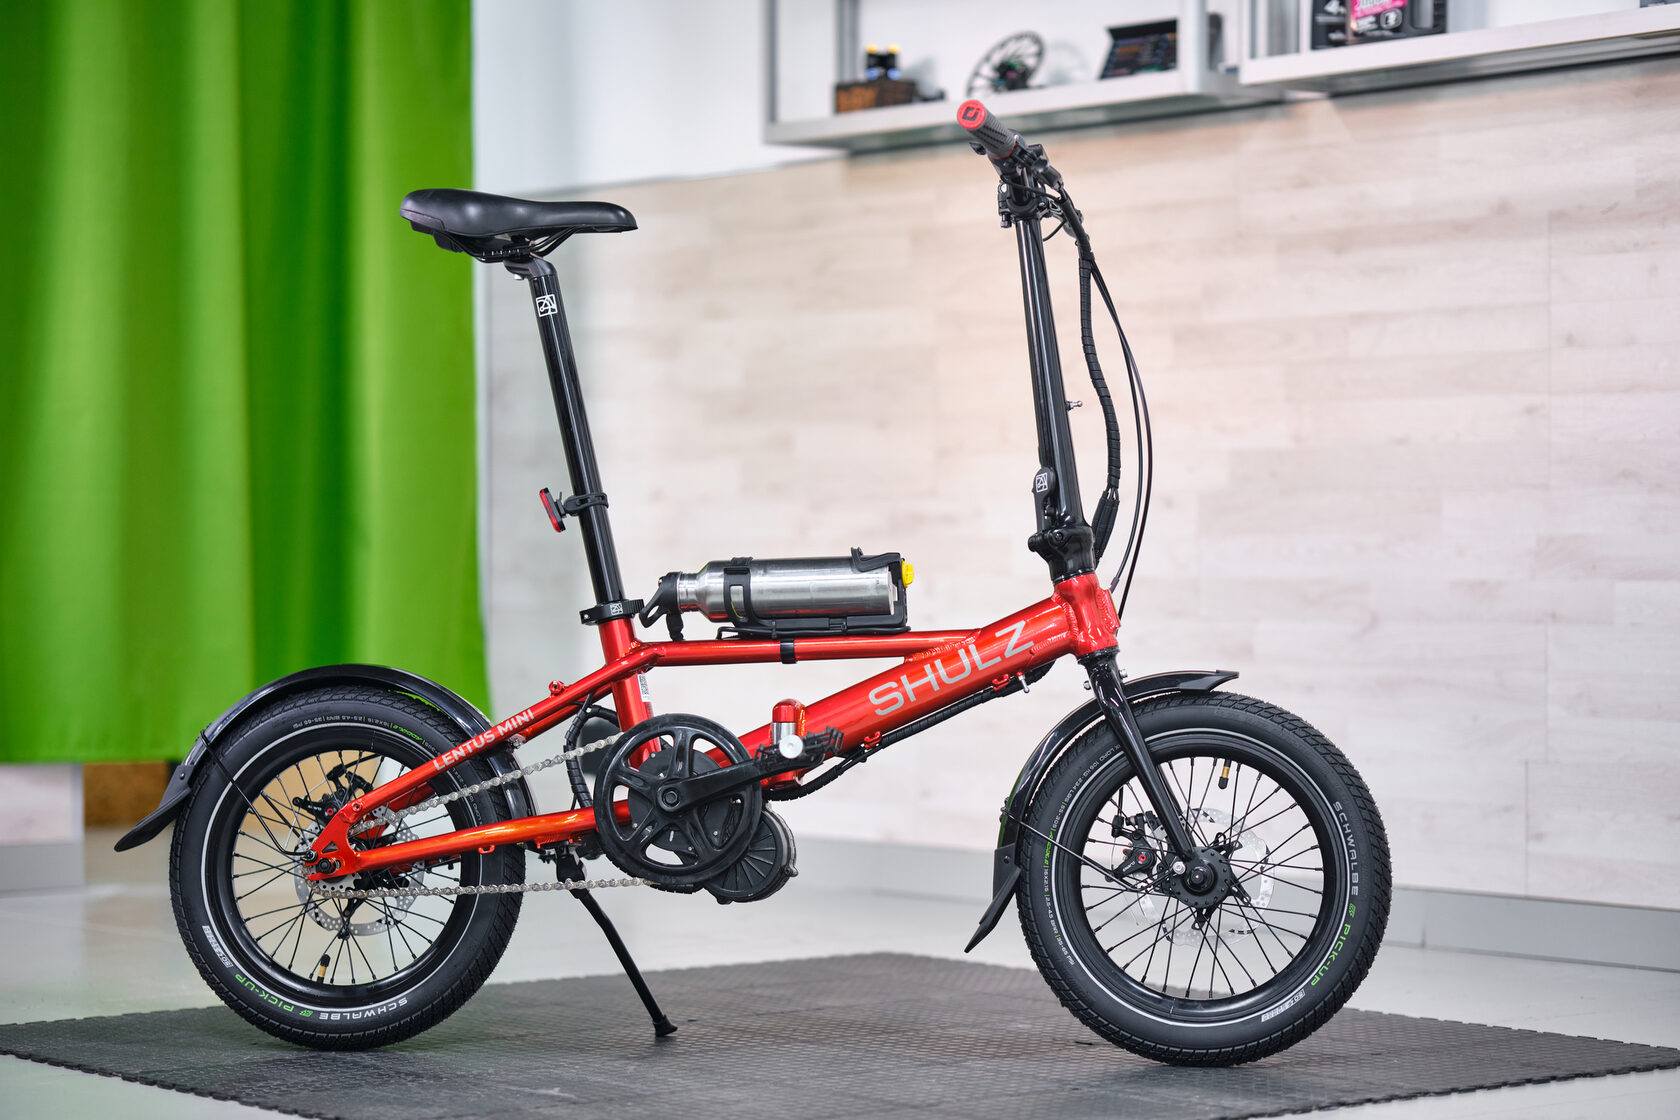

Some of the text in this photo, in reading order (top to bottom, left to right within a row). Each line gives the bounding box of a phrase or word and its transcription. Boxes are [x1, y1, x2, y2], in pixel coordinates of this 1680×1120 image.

[868, 620, 1035, 716] SHULZ
[432, 709, 535, 771] LENTUS MINI
[1310, 801, 1359, 987] SCHWALBE PICK-UP
[1066, 955, 1076, 966] PSI
[235, 973, 408, 1020] SCHWALBE PICK-UP
